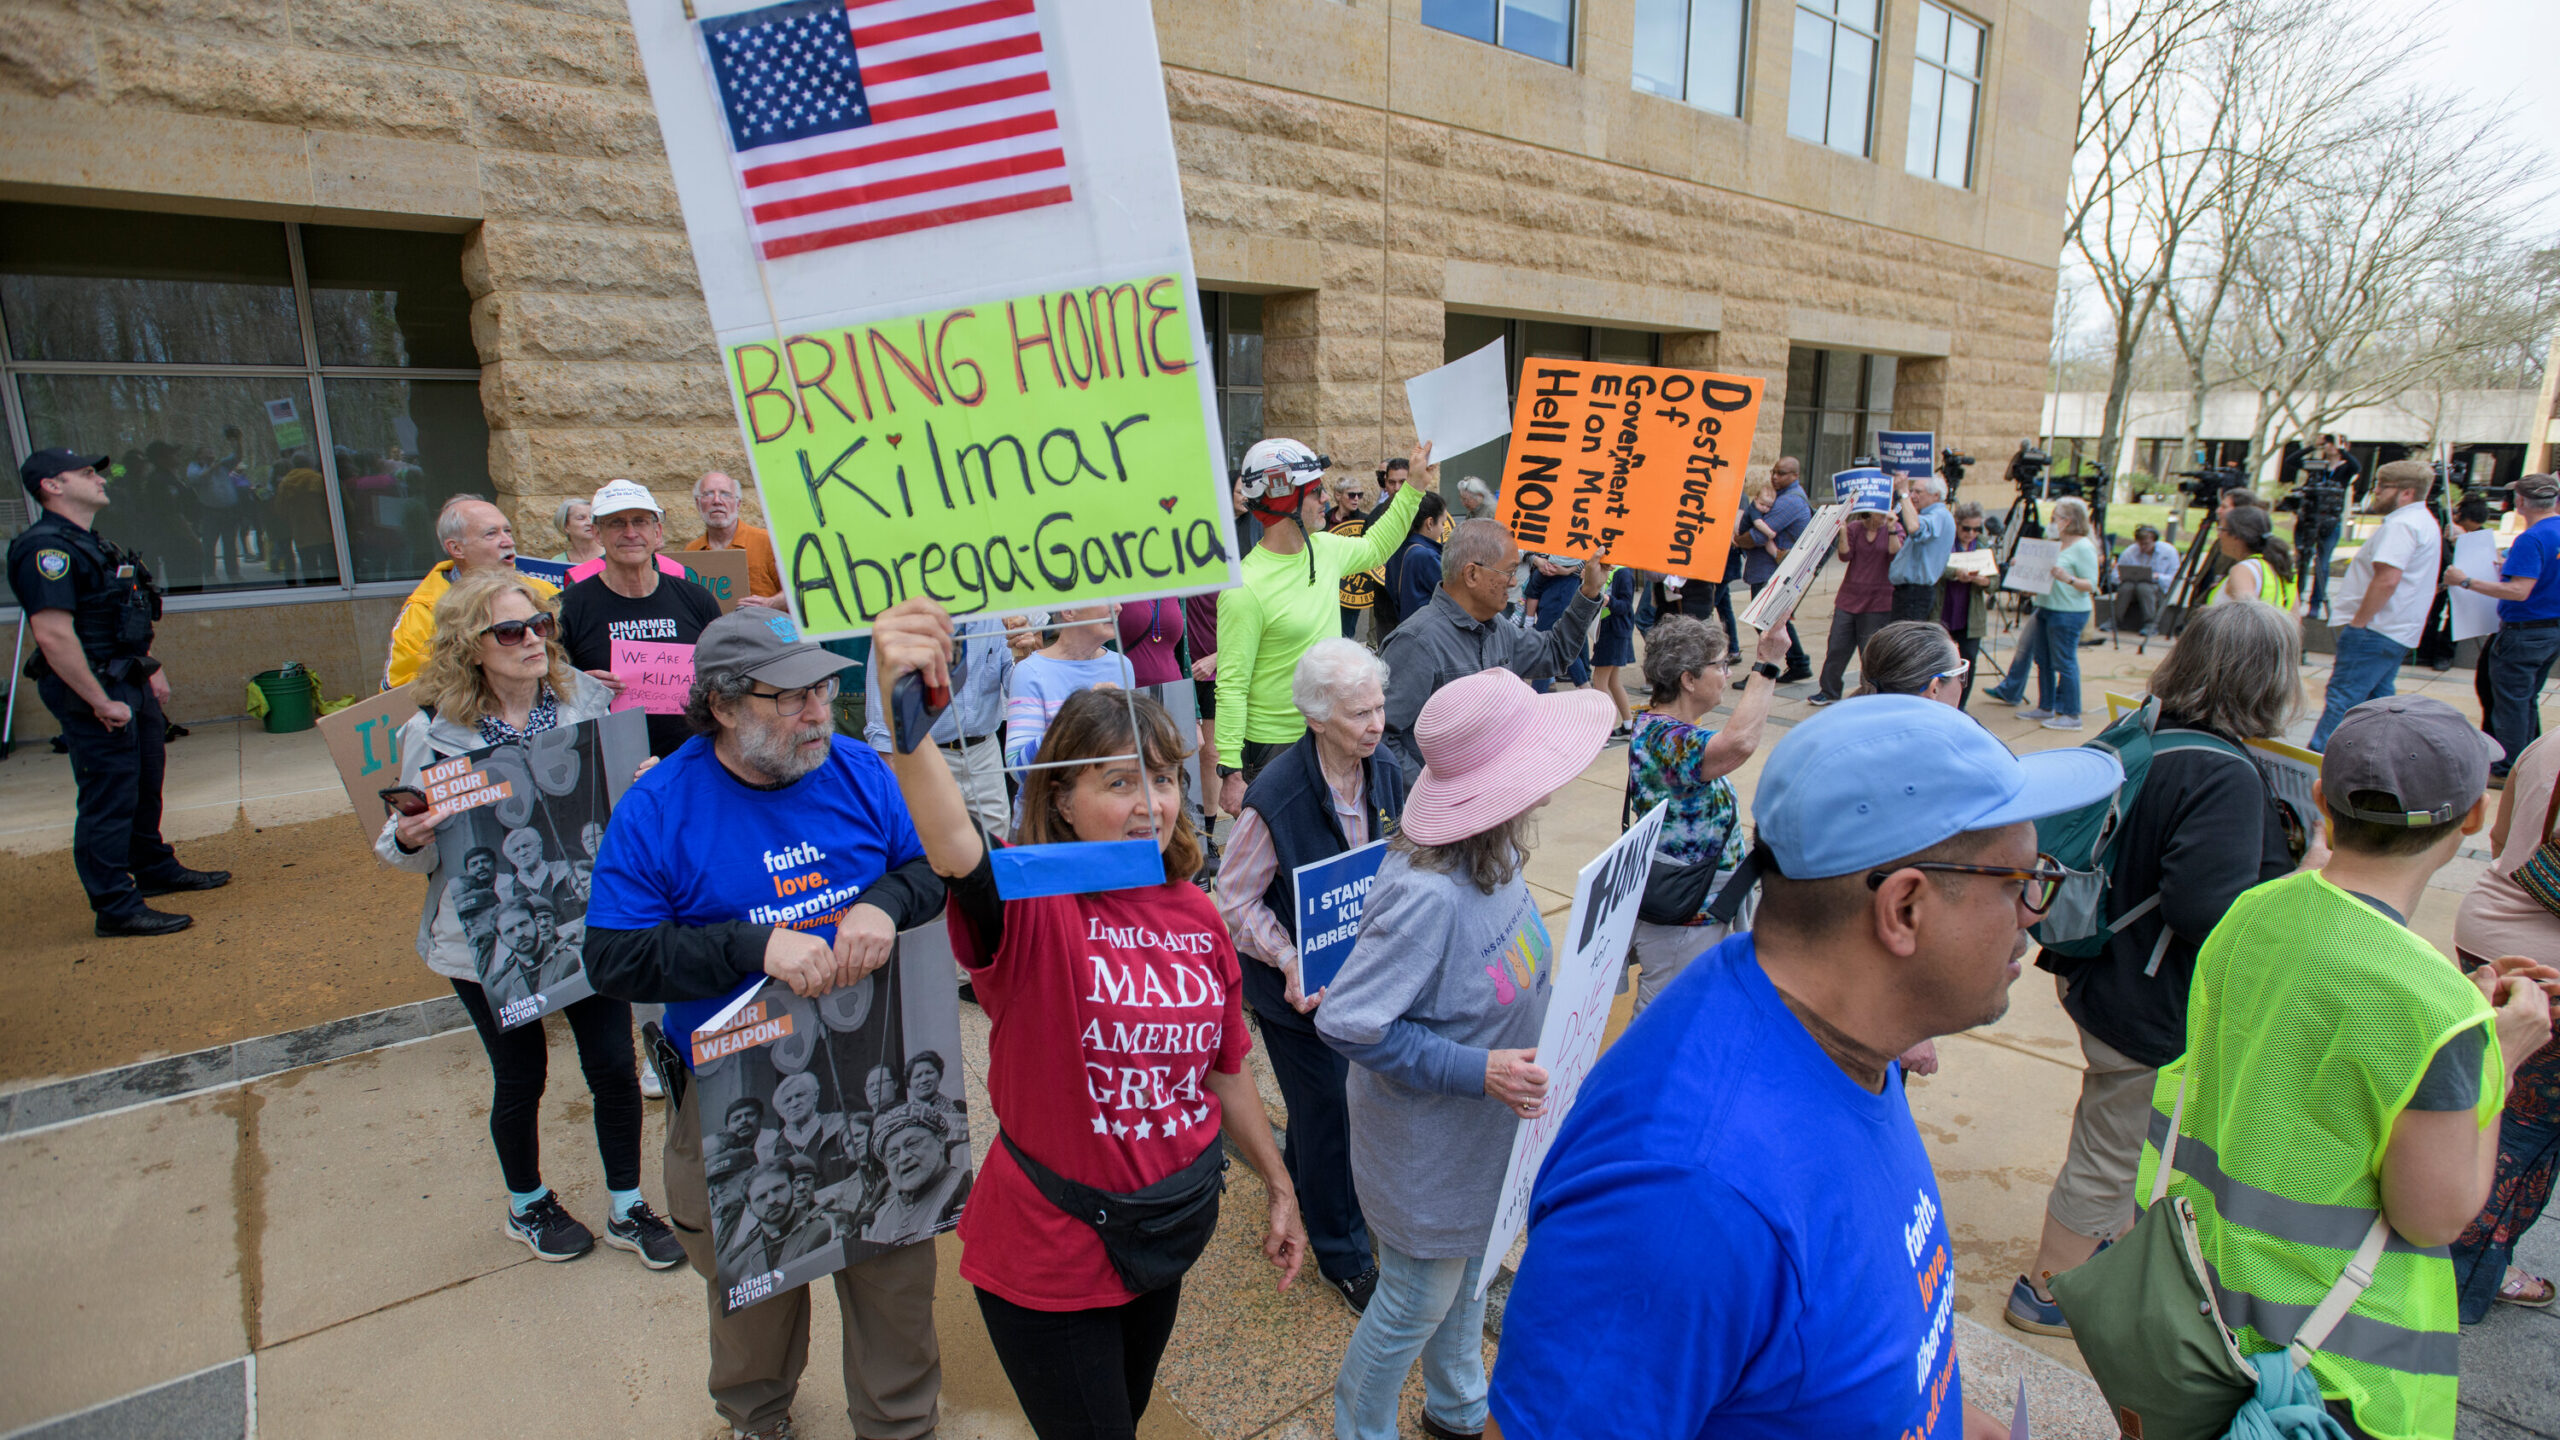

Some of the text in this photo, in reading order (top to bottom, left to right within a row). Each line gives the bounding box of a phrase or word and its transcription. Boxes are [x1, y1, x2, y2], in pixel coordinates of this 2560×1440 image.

[734, 277, 1199, 444] BRING HOME
[1526, 368, 1581, 443] Hell
[1655, 374, 1695, 428] Of
[1883, 441, 1904, 449] STAND
[1905, 442, 1930, 450] WITH
[1900, 456, 1931, 464] GARCIA
[796, 413, 1150, 527] Kilmar
[1566, 374, 1623, 551] Elon Musk
[1667, 379, 1752, 566] Destruction
[1841, 478, 1869, 488] STAND
[1871, 478, 1890, 486] WITH
[528, 571, 564, 584] STAN
[608, 618, 677, 632] UNARMED
[609, 627, 678, 640] CIVILIAN
[622, 649, 649, 664] WE
[655, 651, 680, 664] ARE
[622, 686, 691, 703] ABREGO-GA
[427, 759, 466, 784] LOVE
[431, 773, 483, 801] IS OUR
[435, 785, 507, 814] WEAPON.
[763, 841, 826, 873] faith.
[773, 872, 829, 898] love.
[1309, 875, 1375, 915] I STAND
[1577, 821, 1660, 955] HONK
[1338, 900, 1364, 923] KIL
[1304, 921, 1359, 955] ABREG
[1590, 935, 1611, 975] for
[1086, 956, 1226, 1008] MADE
[498, 995, 536, 1018] FAITH IN
[501, 1004, 540, 1028] ACTION
[1555, 958, 1614, 1069] DUE
[700, 1020, 786, 1060] WEAPON.
[1081, 1017, 1223, 1055] AMERICA
[1904, 1187, 1937, 1268] faith.
[728, 1272, 771, 1299] FAITH IN
[1917, 1244, 1948, 1312] love.
[728, 1283, 773, 1311] ACTION
[1926, 1378, 1941, 1436] all
